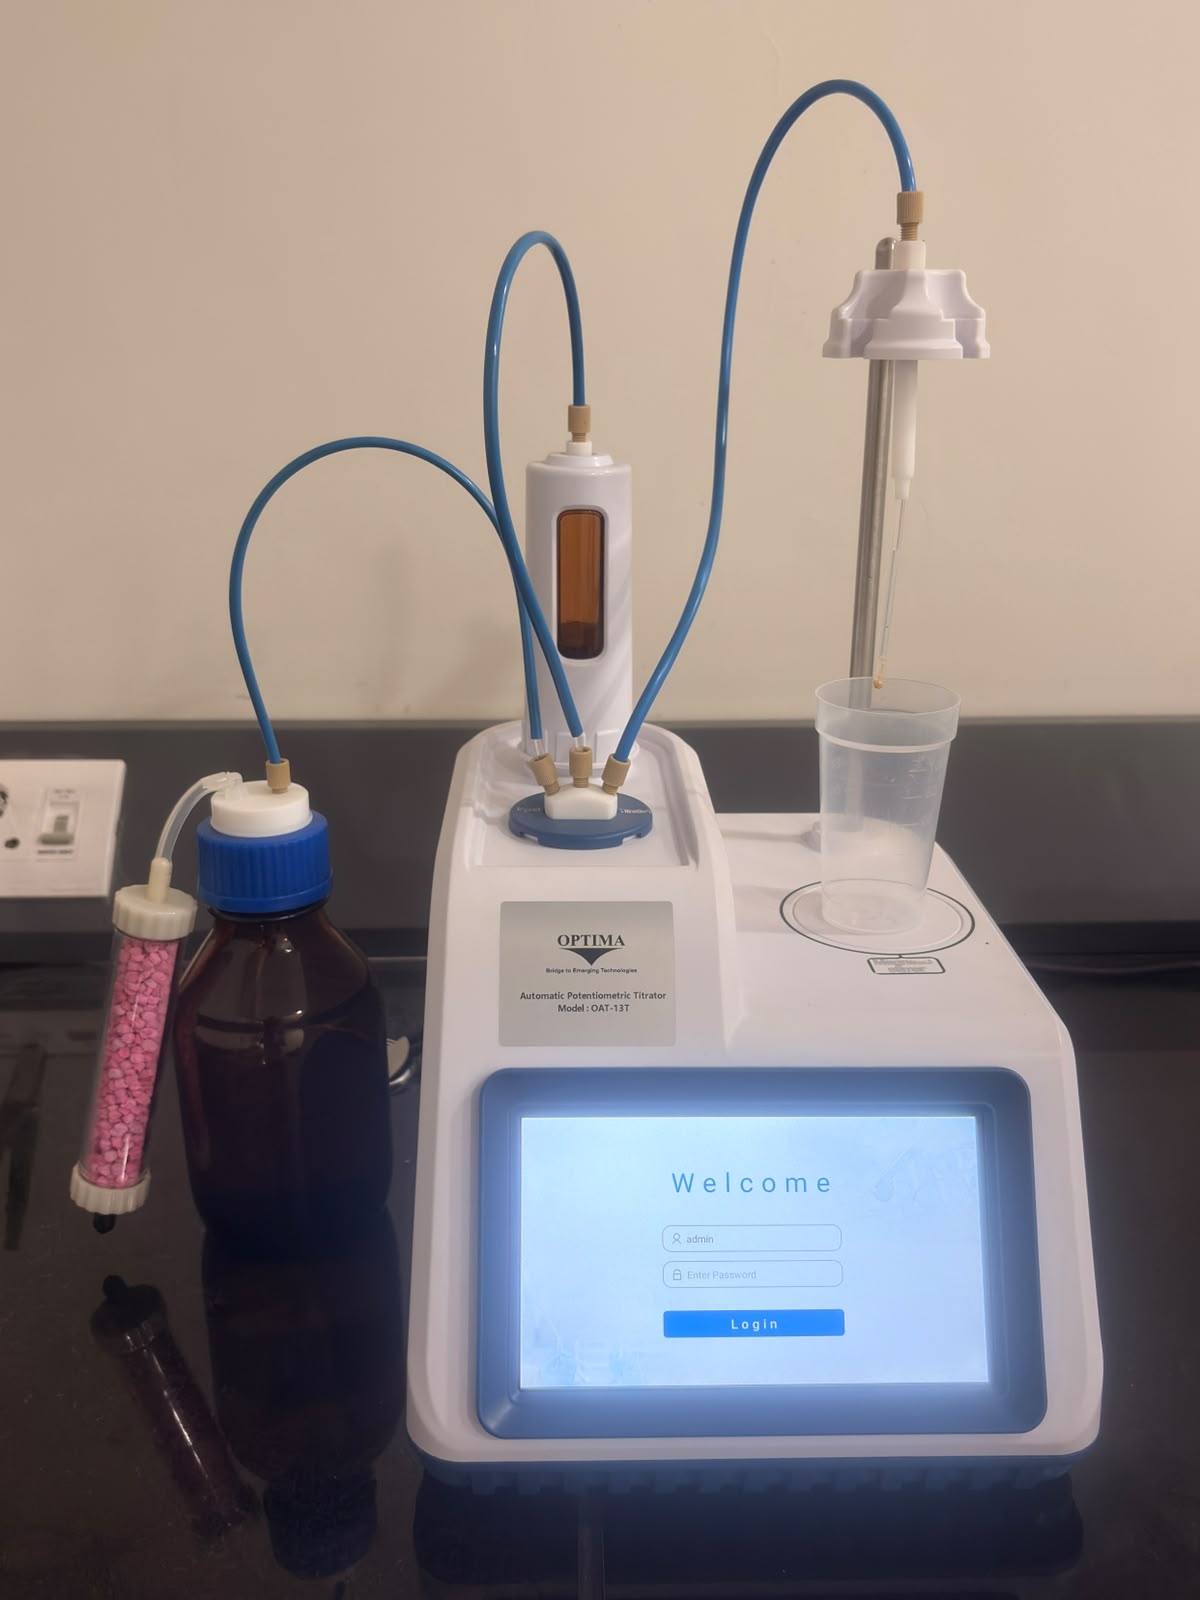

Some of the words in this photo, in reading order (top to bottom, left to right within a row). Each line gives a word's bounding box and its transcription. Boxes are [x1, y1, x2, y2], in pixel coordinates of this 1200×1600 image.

[557, 934, 626, 947] OPTIMA
[545, 967, 565, 975] Bridge
[572, 967, 600, 975] Emerging
[601, 967, 638, 975] Technologies
[519, 991, 565, 1000] Automatic
[567, 991, 631, 1000] Potentiometric
[633, 991, 667, 1000] Titrator
[557, 1004, 585, 1013] Model
[591, 1004, 630, 1013] OAT-13T
[671, 1171, 831, 1193] Welcome
[686, 1234, 714, 1244] admin
[687, 1270, 710, 1280] Enter
[712, 1270, 757, 1280] Password
[730, 1318, 778, 1331] Login
